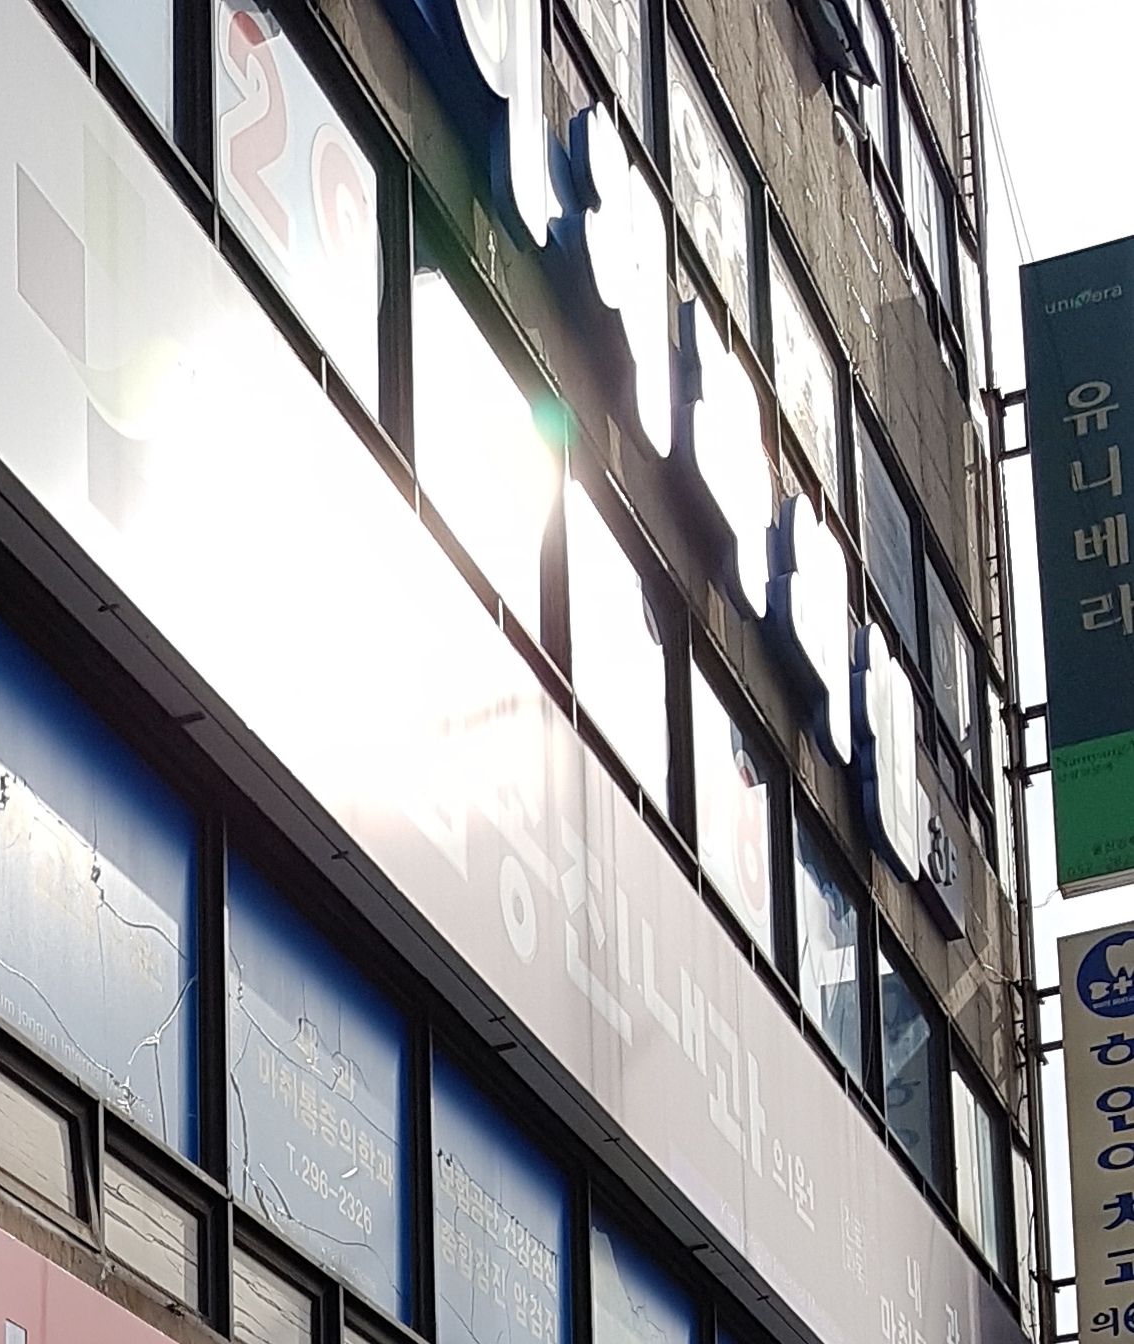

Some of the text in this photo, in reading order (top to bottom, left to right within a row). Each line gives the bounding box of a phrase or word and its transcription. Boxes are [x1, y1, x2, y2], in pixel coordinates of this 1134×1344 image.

[1063, 381, 1134, 636] 유니베라
[258, 1051, 394, 1197] 마취통증의학과
[285, 1141, 372, 1235] T.296-2326
[772, 1138, 816, 1232] 의원
[503, 1215, 558, 1299] 건강검진
